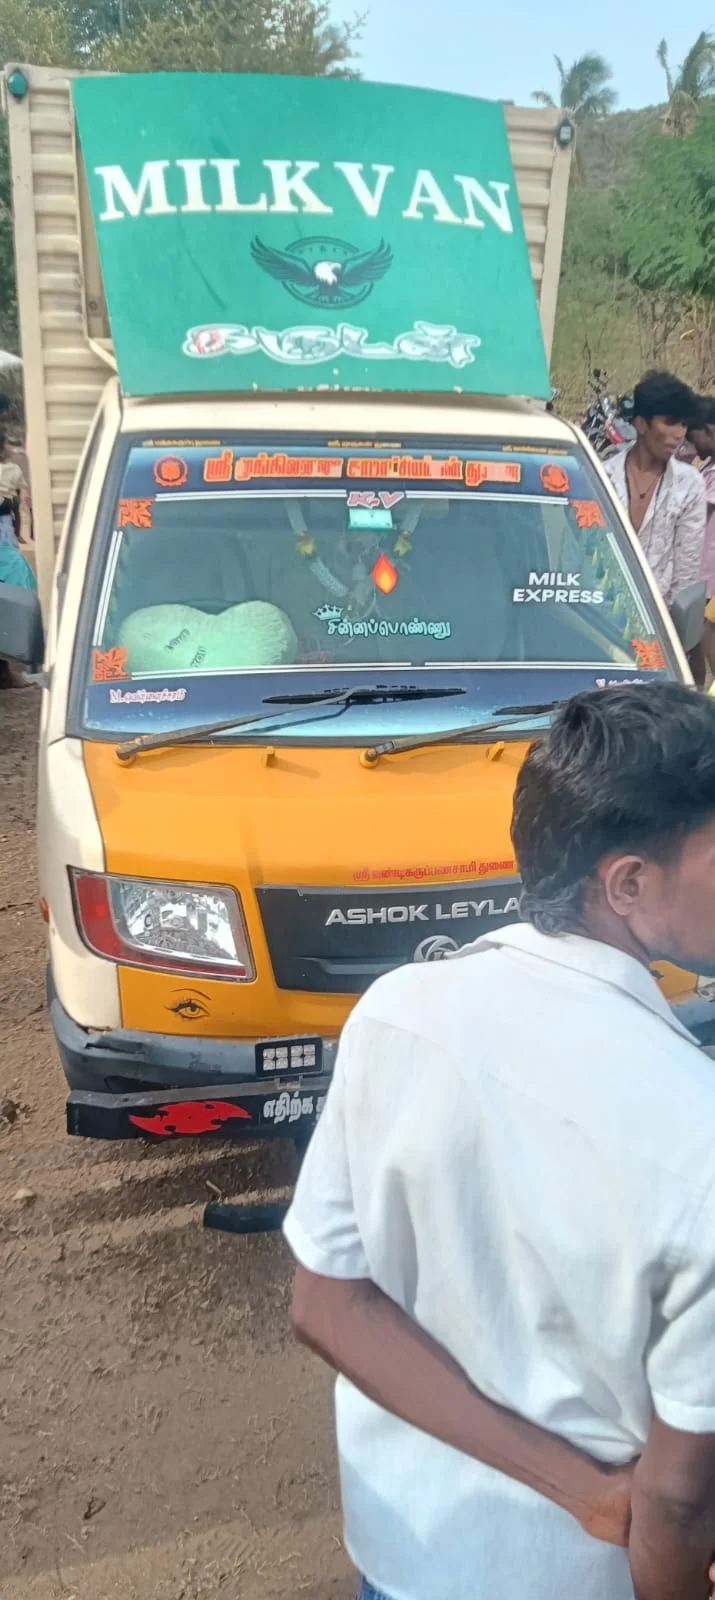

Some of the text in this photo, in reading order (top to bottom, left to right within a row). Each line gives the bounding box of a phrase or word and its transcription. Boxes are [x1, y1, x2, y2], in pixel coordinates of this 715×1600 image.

[94, 158, 513, 233] MILK VAN
[528, 572, 580, 586] MILK
[513, 588, 604, 604] EXPRESS
[327, 617, 451, 639] சின்னப்பொண்ணு
[325, 897, 520, 926] ASHOK LEYLA
